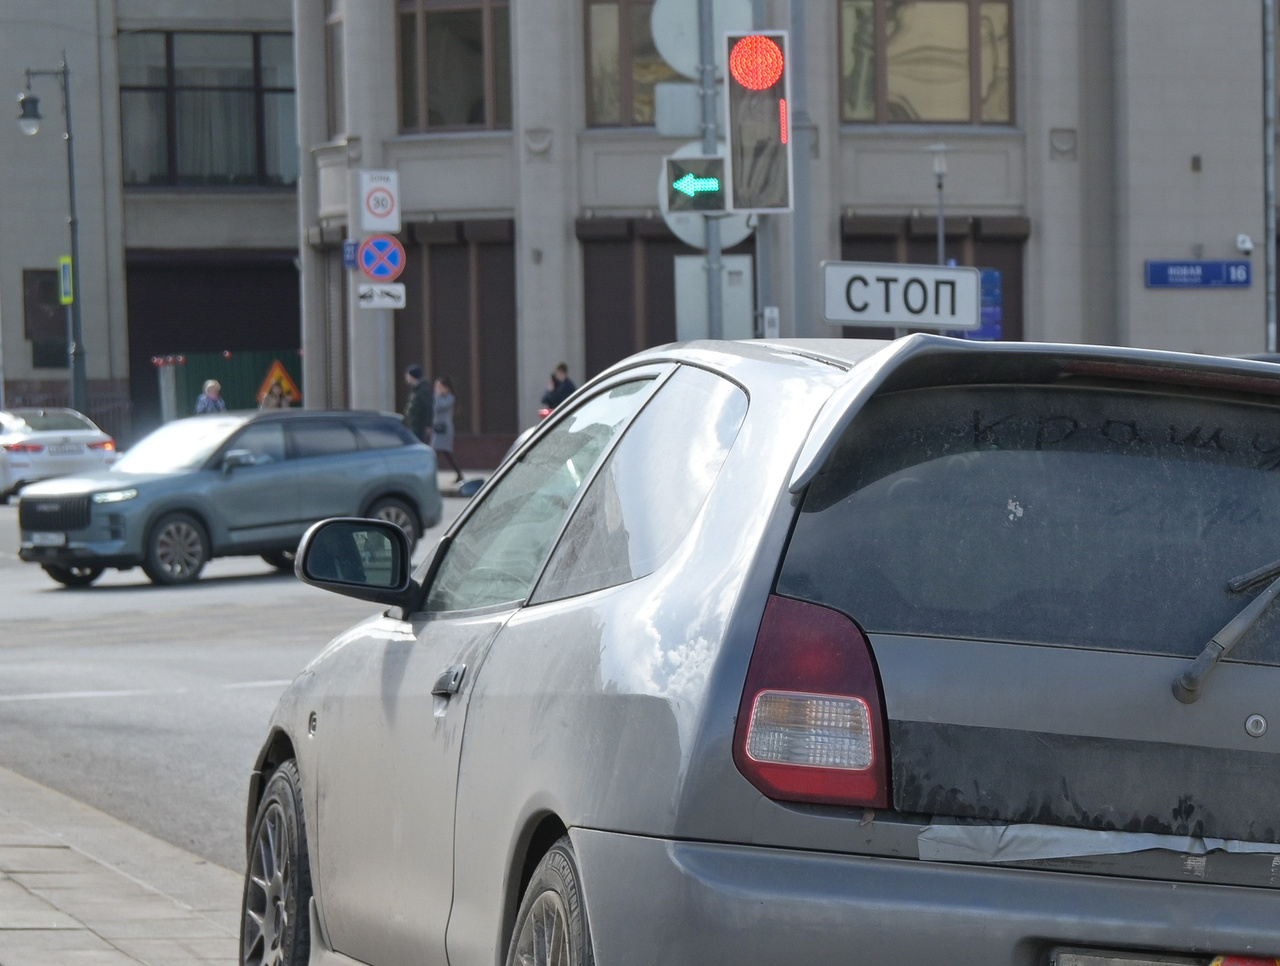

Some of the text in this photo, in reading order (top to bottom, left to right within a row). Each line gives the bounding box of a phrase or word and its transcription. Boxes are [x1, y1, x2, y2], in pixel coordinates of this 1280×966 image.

[373, 195, 389, 210] 30
[1228, 264, 1247, 283] 16
[845, 274, 956, 316] СТОП
